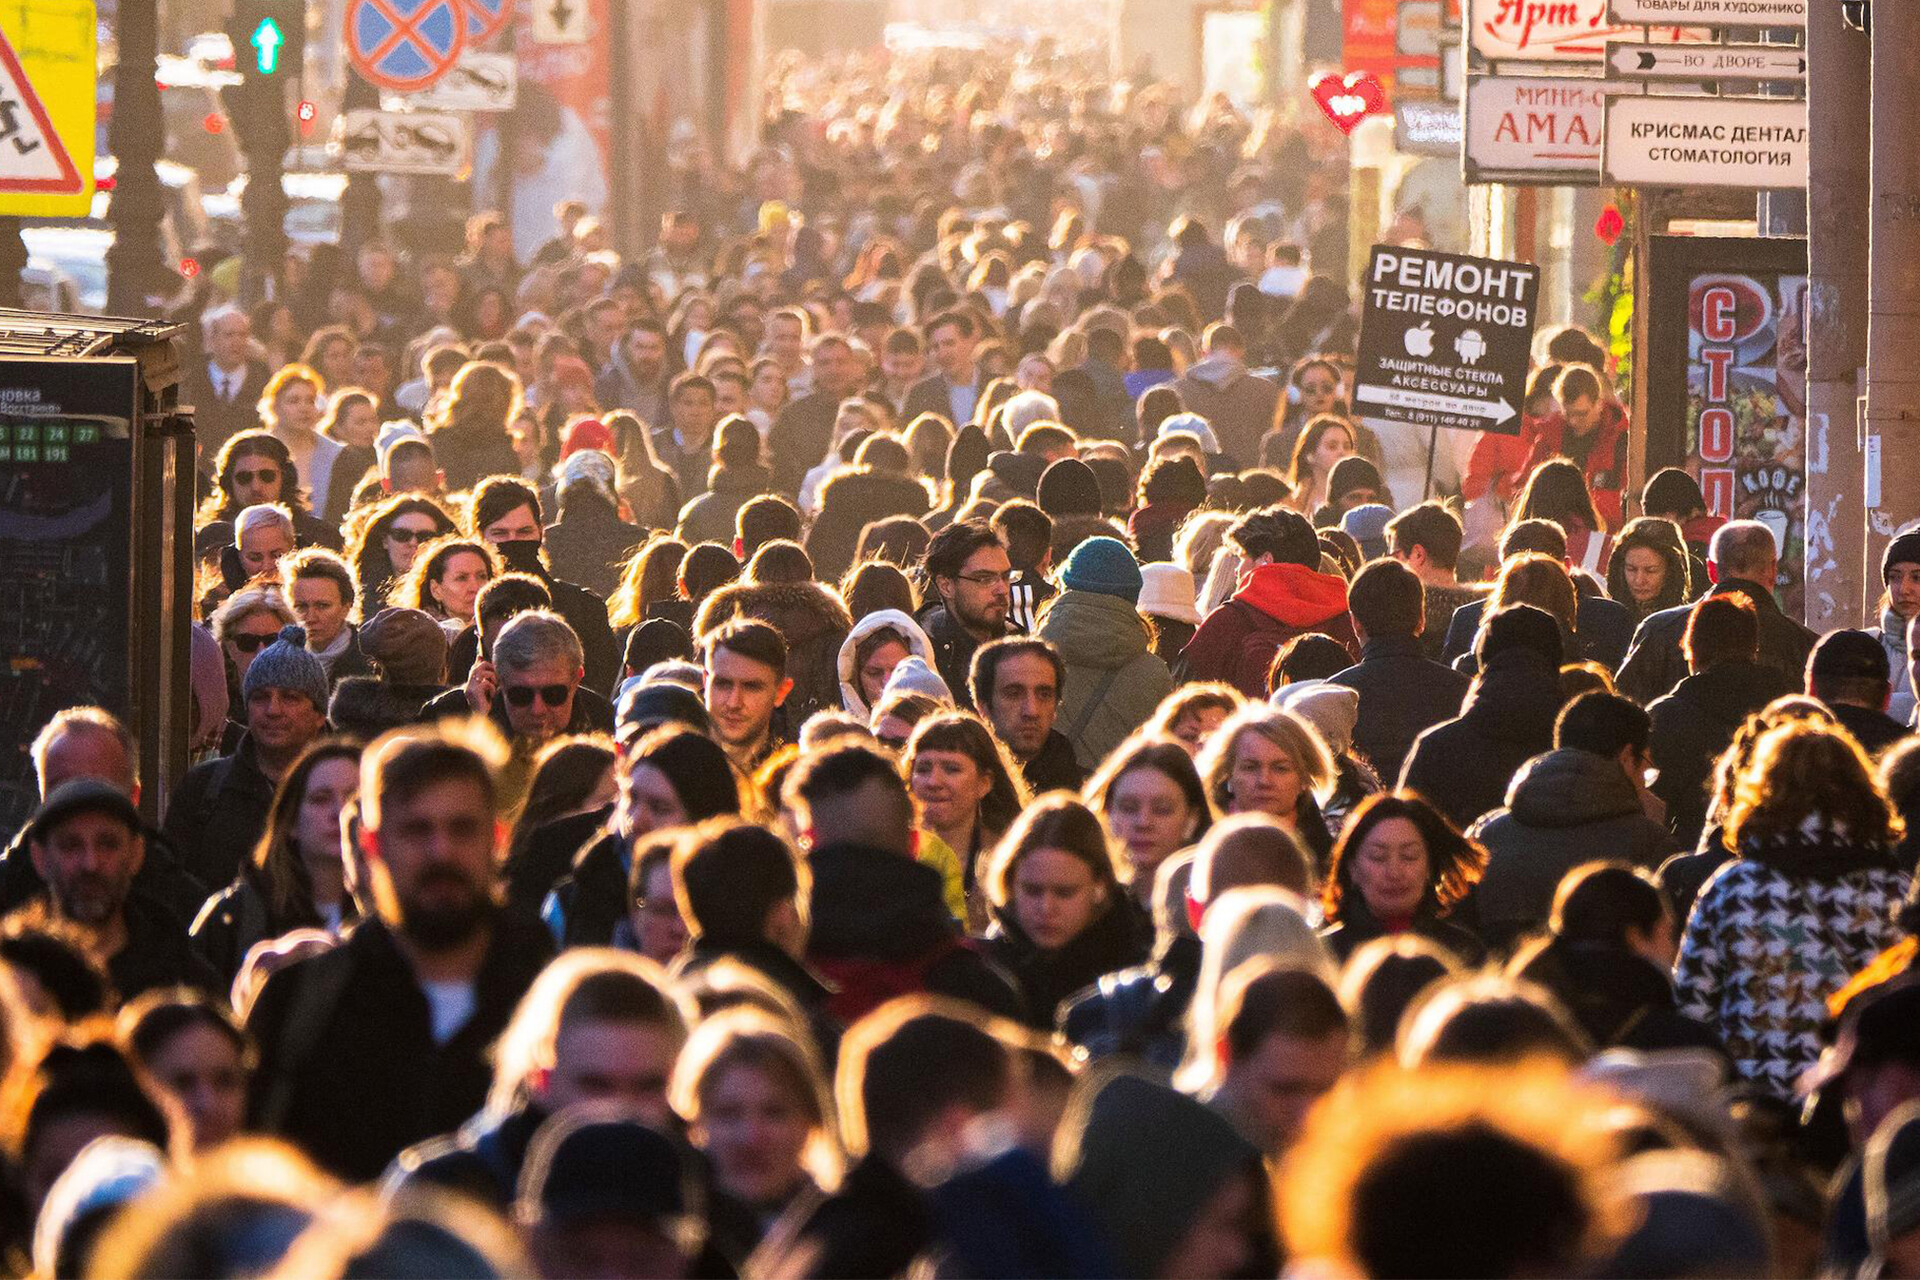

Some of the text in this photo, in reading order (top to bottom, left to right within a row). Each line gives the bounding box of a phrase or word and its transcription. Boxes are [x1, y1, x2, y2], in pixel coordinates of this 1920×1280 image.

[1637, 0, 1806, 14] ТОВАРЫ ДЛЯ ХУДОЖНИКО
[1684, 55, 1766, 69] ВО ДВОРЕ
[1631, 123, 1725, 140] КРИСМАС
[1649, 148, 1791, 166] СТОМАТОЛОГИЯ
[1373, 253, 1533, 301] РЕМОНТ
[1372, 289, 1527, 328] ТЕЛЕФОНОВ
[1379, 357, 1504, 385] ЗАЩИТНЫЕ СТЕКЛА
[1392, 375, 1488, 397] АКСЕССУАРЫ
